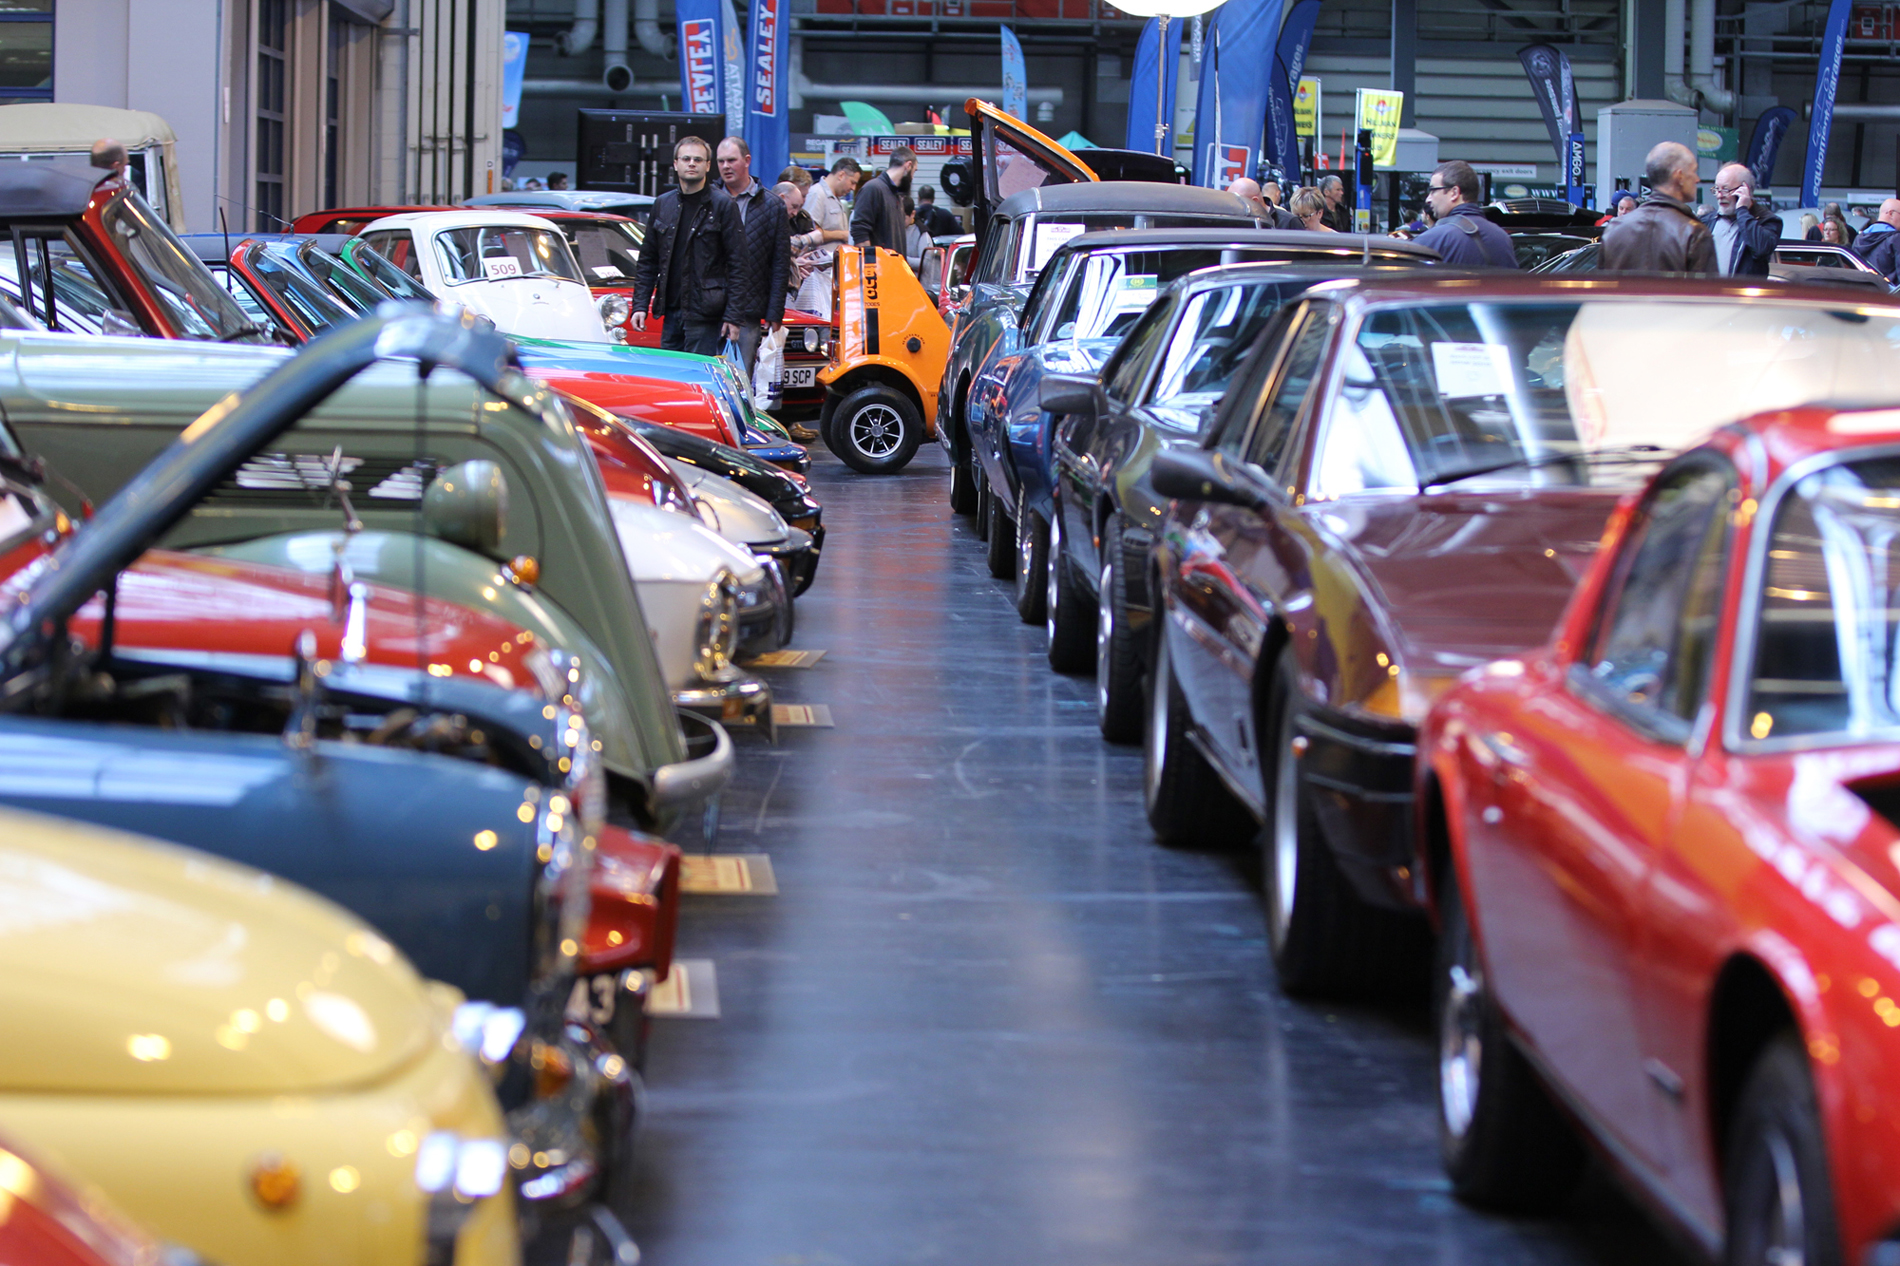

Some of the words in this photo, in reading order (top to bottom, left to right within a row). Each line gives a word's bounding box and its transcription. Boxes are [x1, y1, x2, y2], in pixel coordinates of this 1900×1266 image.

[756, 4, 774, 106] SEALEY
[917, 140, 942, 151] SEALEY
[1572, 141, 1583, 176] AMGO
[491, 264, 517, 275] 509
[792, 369, 811, 384] SCP
